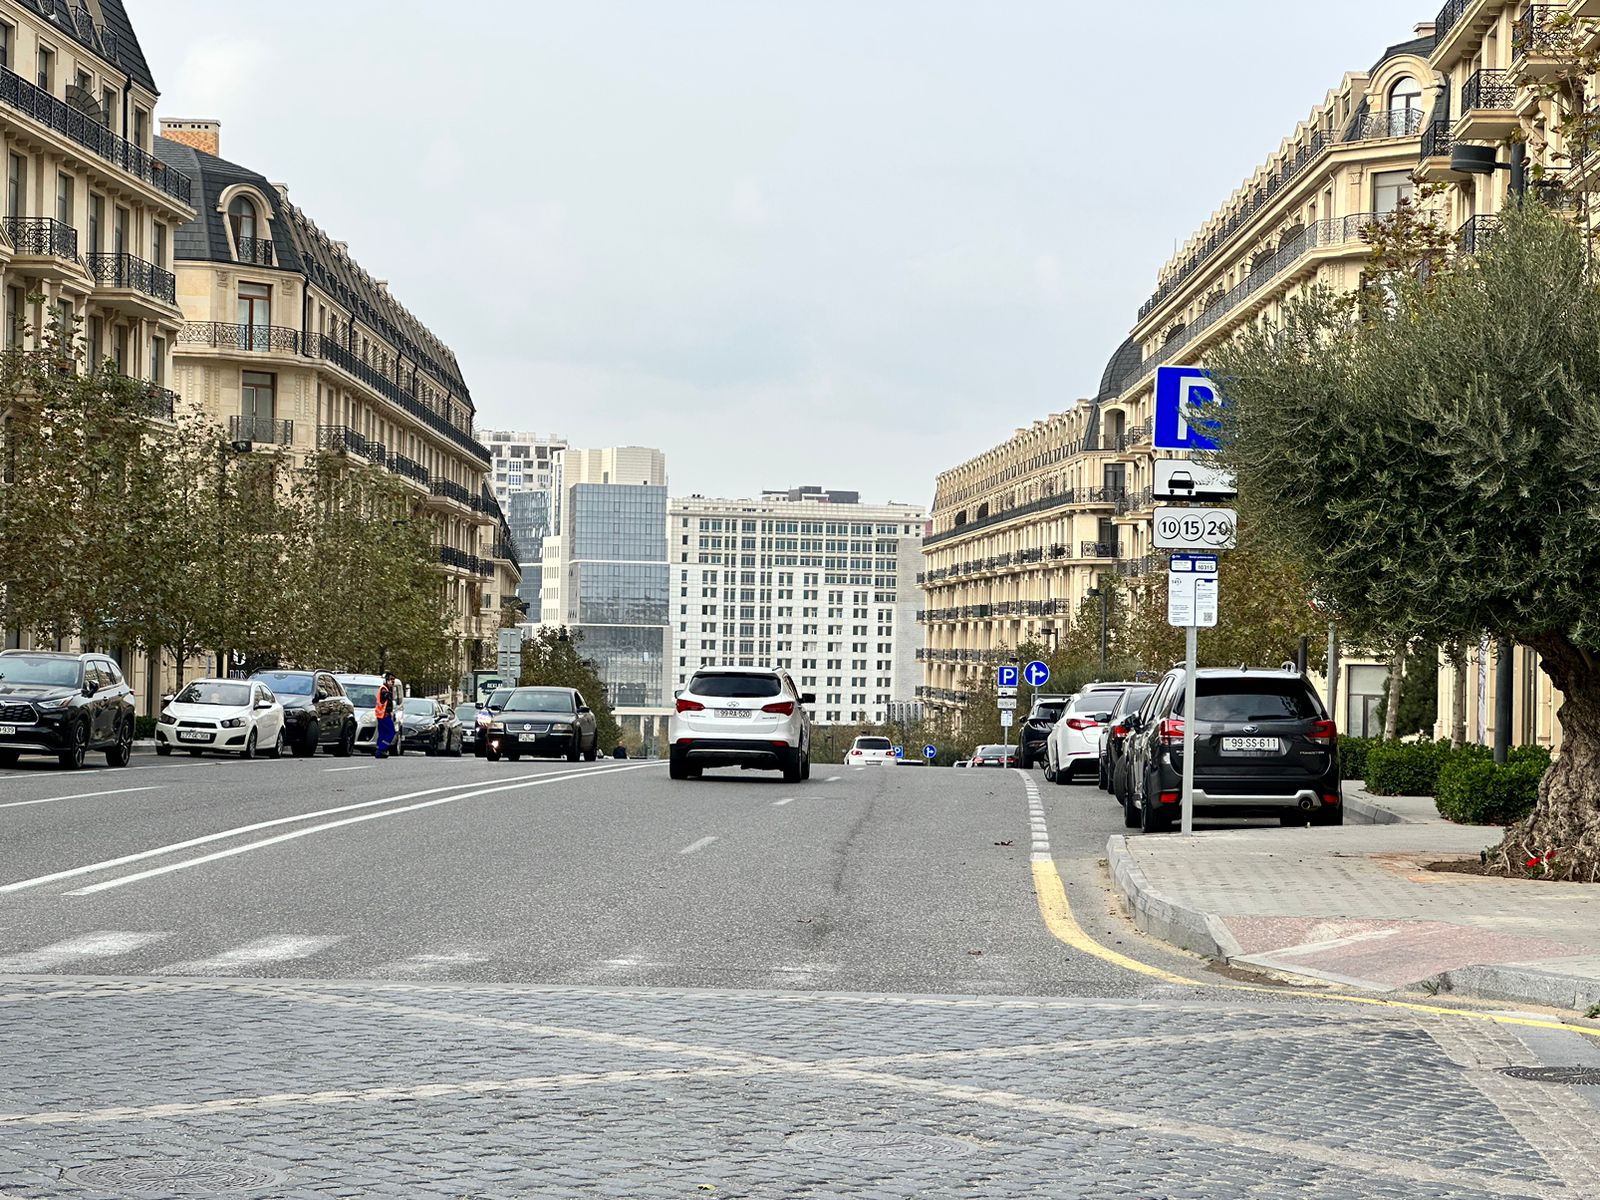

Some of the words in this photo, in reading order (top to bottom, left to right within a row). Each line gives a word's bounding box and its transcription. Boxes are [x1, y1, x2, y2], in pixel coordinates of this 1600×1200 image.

[1177, 376, 1222, 440] P
[1162, 521, 1176, 533] 10
[1183, 521, 1200, 535] 15
[1207, 521, 1228, 535] 20
[1003, 668, 1015, 684] P
